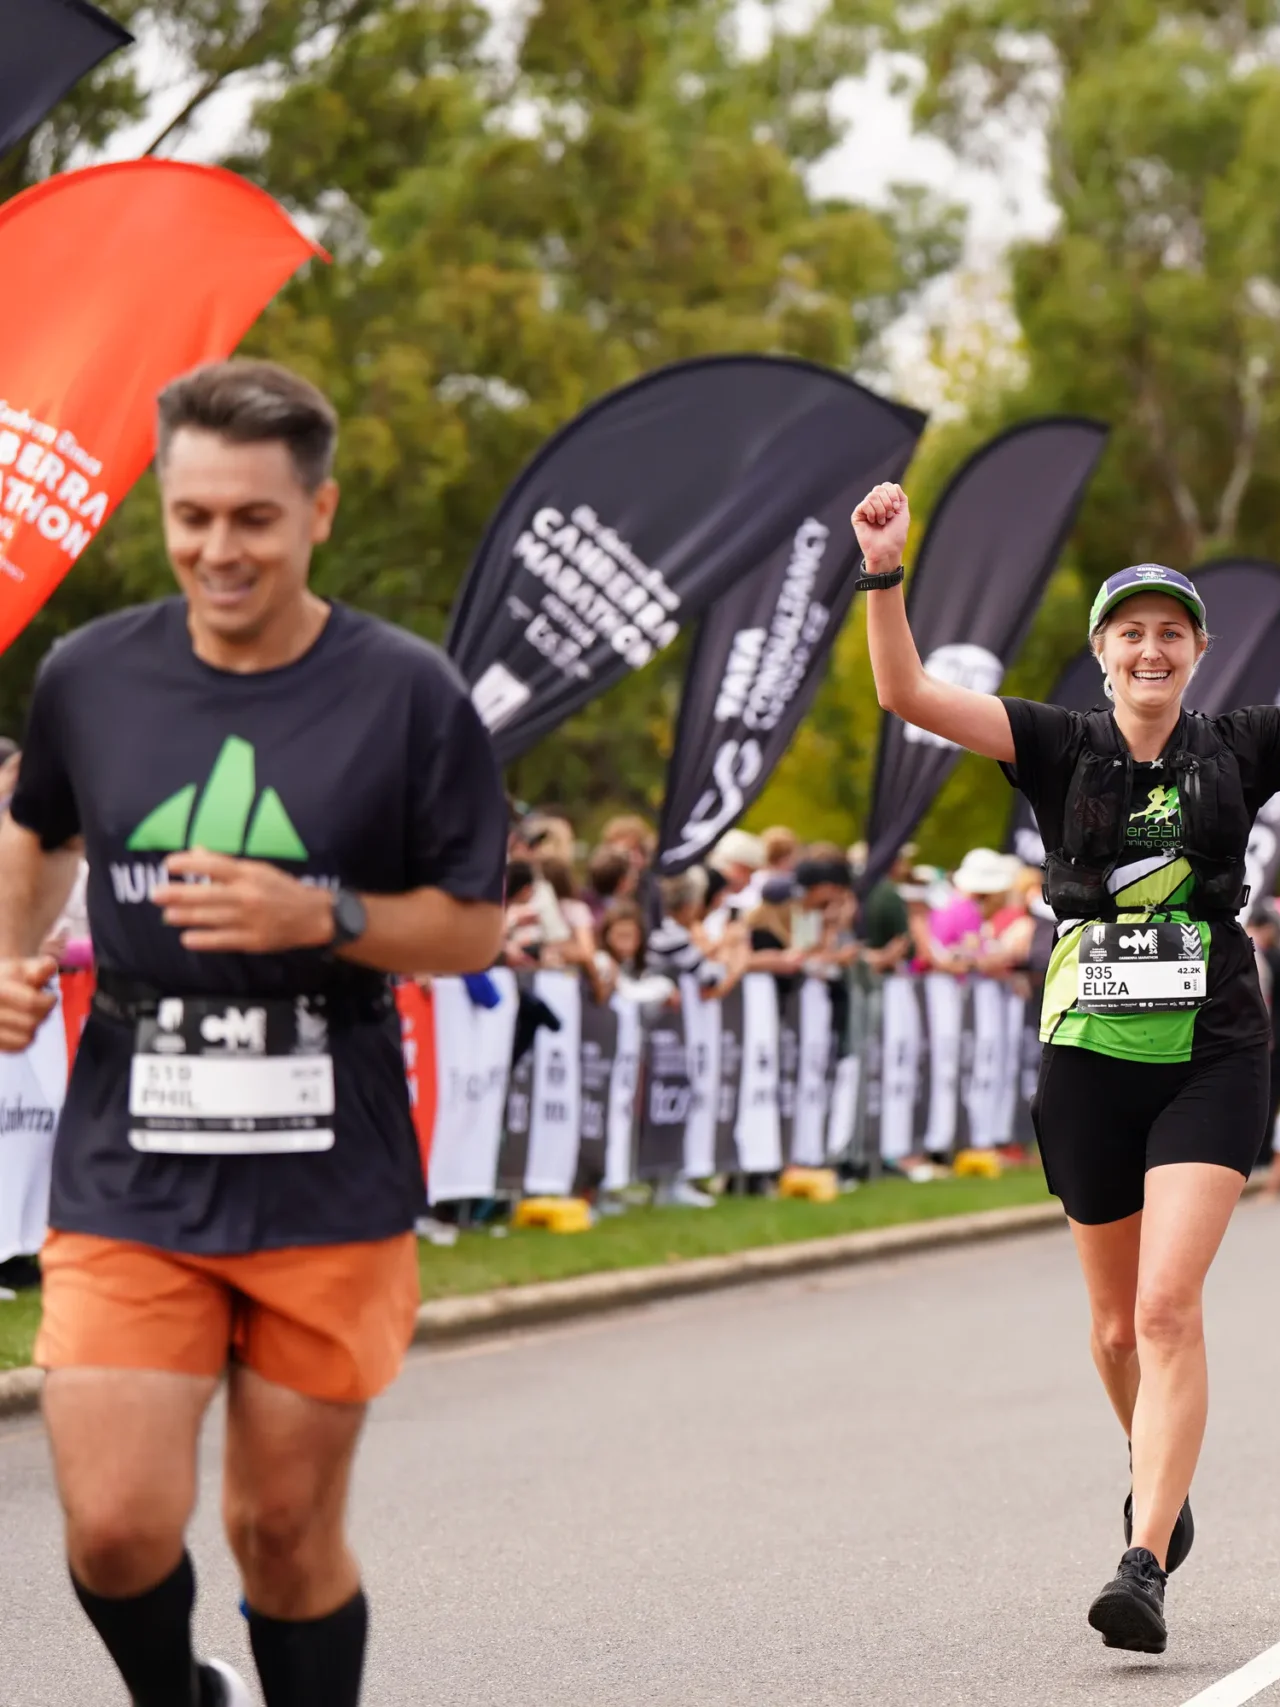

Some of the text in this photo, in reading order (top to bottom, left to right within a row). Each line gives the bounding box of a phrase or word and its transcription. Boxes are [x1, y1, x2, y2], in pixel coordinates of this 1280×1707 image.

[0, 472, 92, 560] THON
[513, 530, 655, 670] MARATHON
[532, 506, 680, 650] CANBERRA
[714, 627, 767, 722] TATA
[1126, 824, 1182, 838] er2Eli
[1083, 981, 1130, 996] ELIZA
[1085, 966, 1112, 980] 935
[1184, 981, 1191, 990] B
